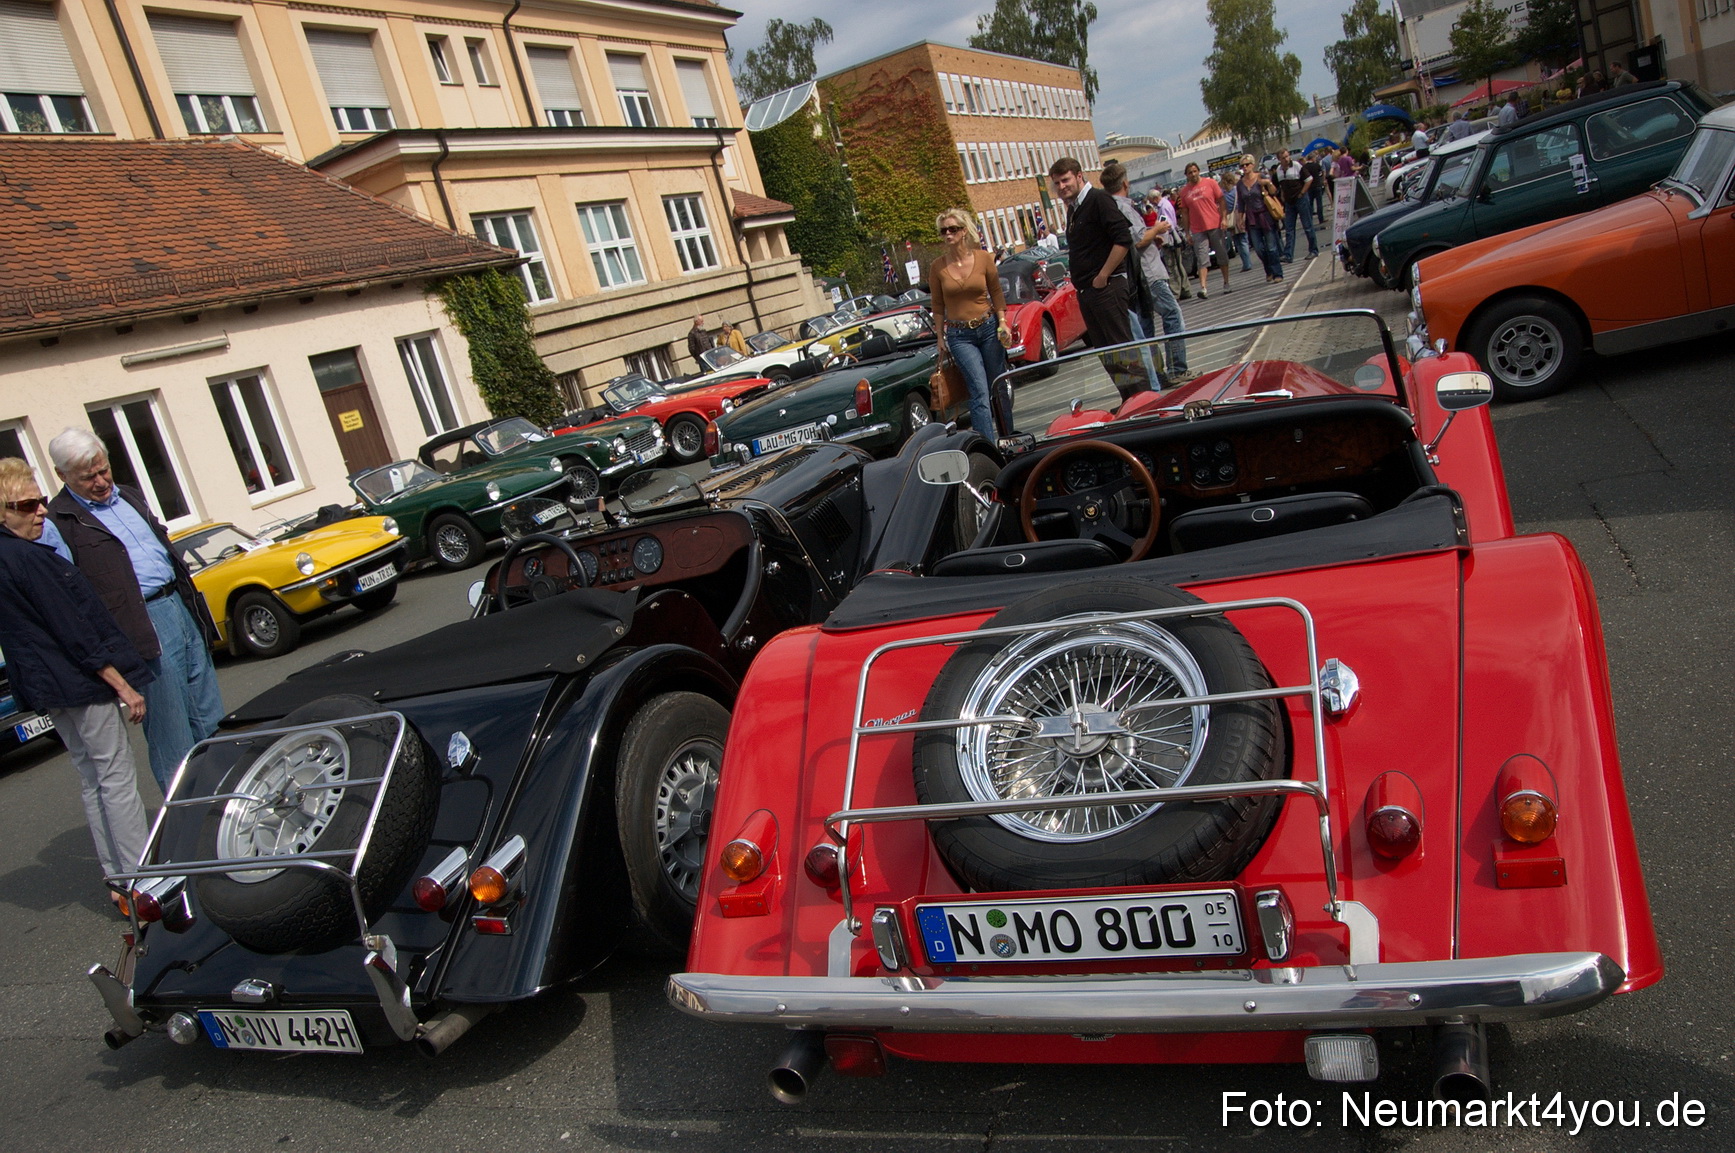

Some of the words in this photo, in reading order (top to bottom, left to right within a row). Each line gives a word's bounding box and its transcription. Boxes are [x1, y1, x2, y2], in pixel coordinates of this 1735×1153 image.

[760, 436, 778, 452] LAU
[784, 431, 797, 446] MG
[797, 426, 817, 442] 70H
[360, 574, 376, 589] WUN
[865, 708, 917, 728] Morgan
[23, 723, 35, 737] N
[1204, 901, 1228, 915] 05
[947, 912, 986, 955] N
[1011, 907, 1083, 954] MO
[1094, 903, 1197, 952] 800
[1211, 932, 1234, 947] 10
[215, 1016, 241, 1043] N
[245, 1017, 283, 1046] VV
[288, 1016, 357, 1048] 442H
